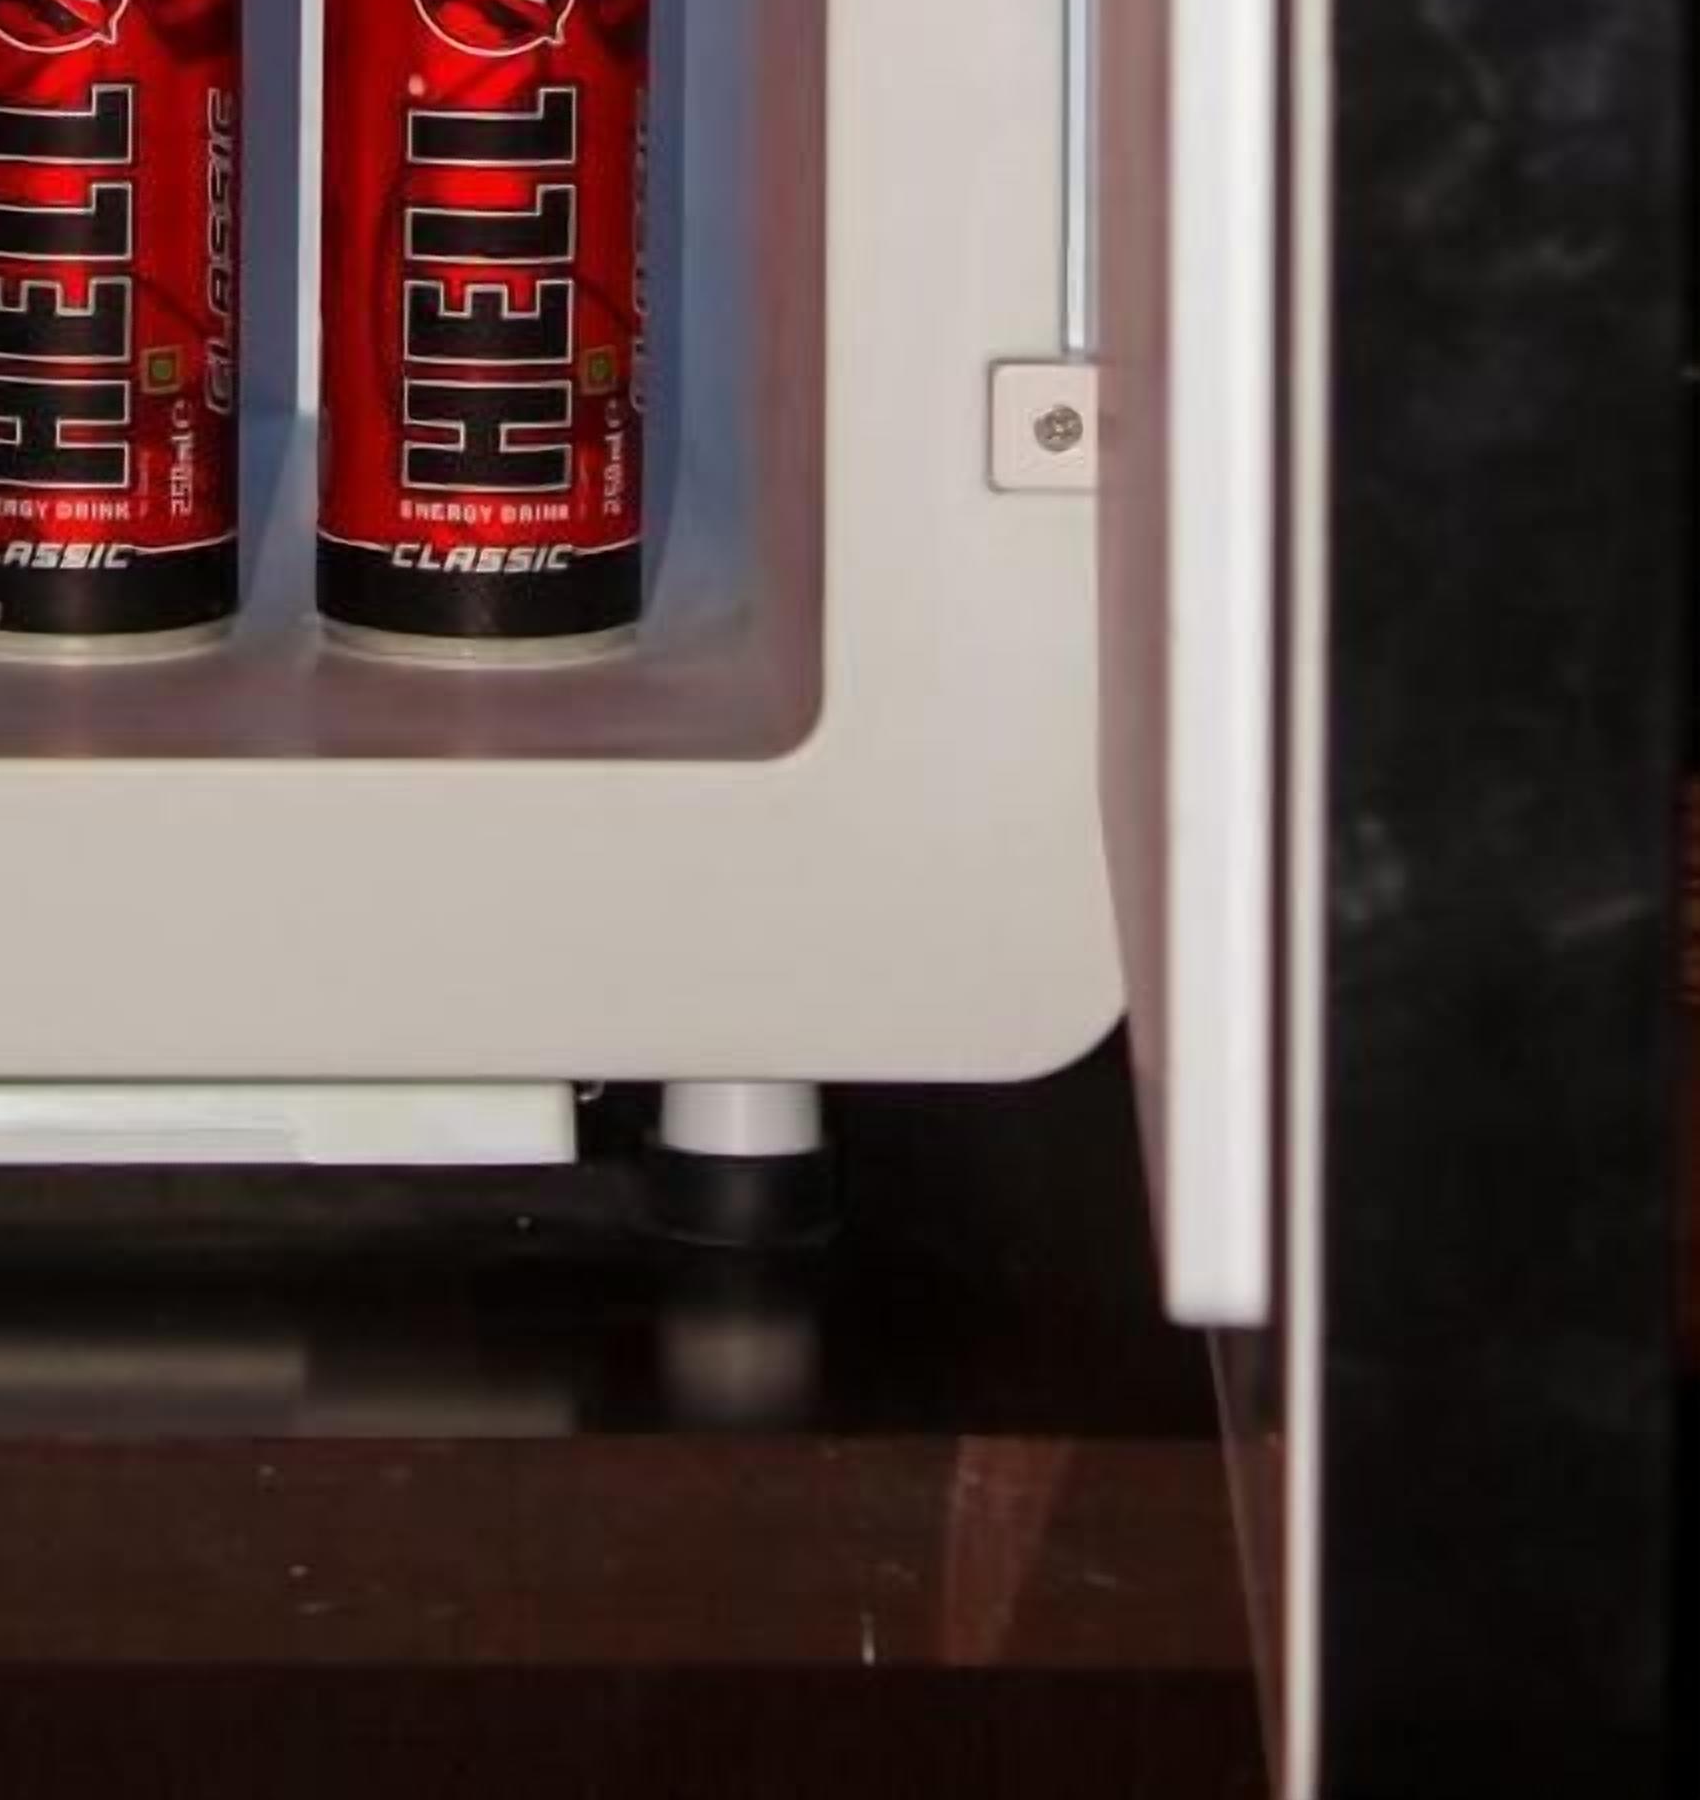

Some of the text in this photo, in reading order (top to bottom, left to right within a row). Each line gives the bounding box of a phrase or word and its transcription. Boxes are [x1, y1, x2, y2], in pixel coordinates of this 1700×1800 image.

[206, 86, 236, 416] CLASSIC
[402, 85, 577, 492] HELL
[56, 499, 131, 521] DRINK
[401, 499, 493, 524] ENERGY
[391, 542, 575, 573] CLASSIC
